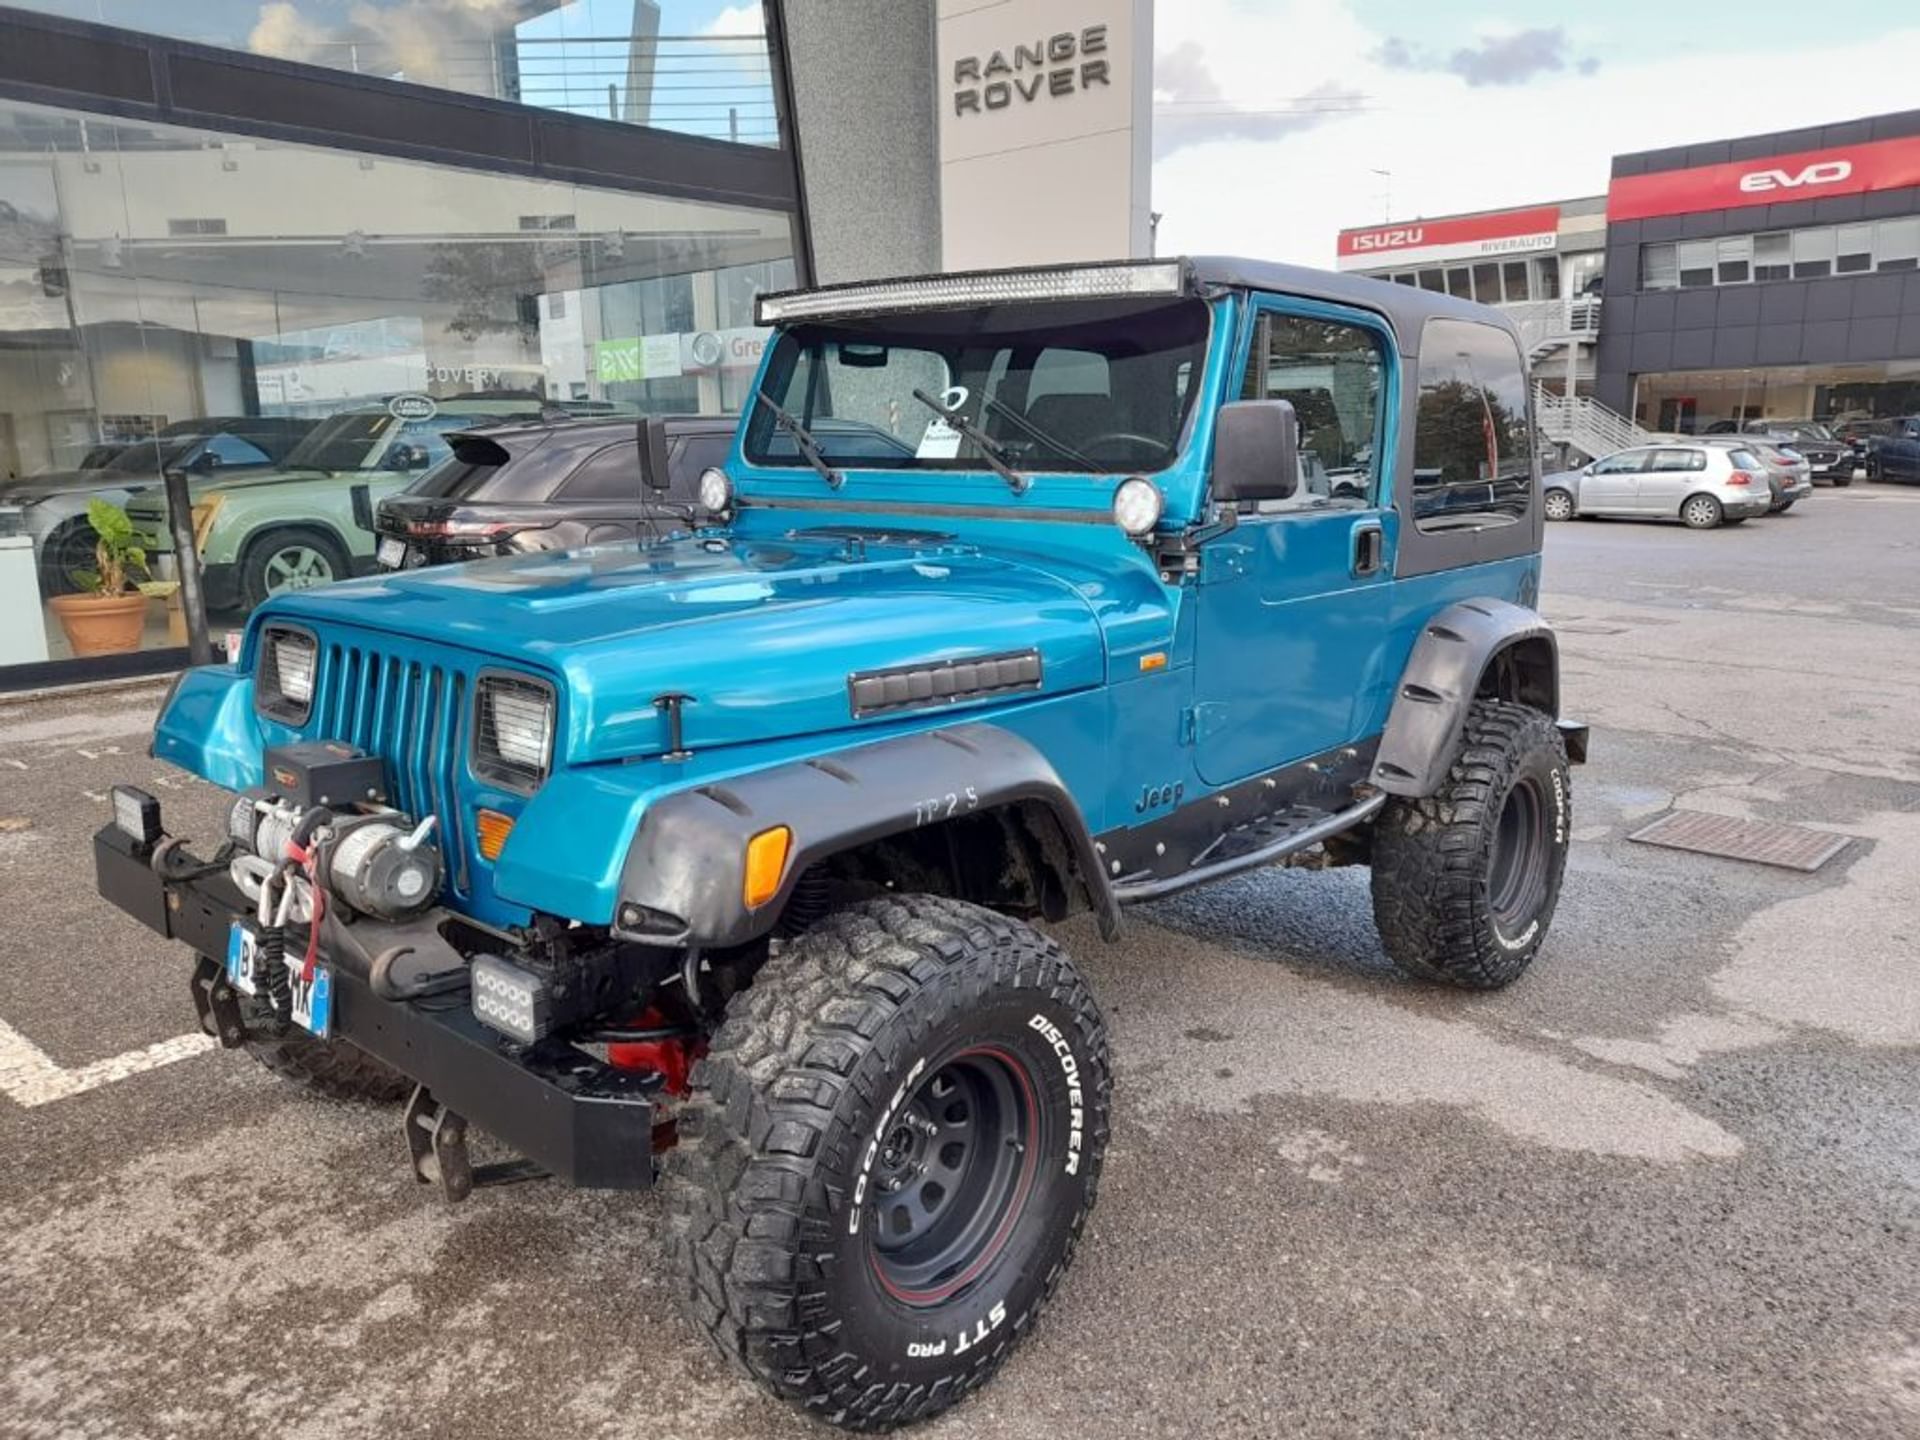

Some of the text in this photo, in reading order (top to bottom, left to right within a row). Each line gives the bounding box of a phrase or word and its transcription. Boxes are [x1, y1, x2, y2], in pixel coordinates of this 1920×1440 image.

[954, 24, 1107, 84] RANGE
[954, 60, 1110, 117] ROVER
[1740, 161, 1852, 192] EVO
[1352, 228, 1423, 250] ISUZU
[1481, 235, 1553, 252] RIVERAUTO
[1135, 780, 1184, 813] Jeep
[1028, 1013, 1084, 1176] DISCOVERER
[907, 1299, 1006, 1357] STT PRO
